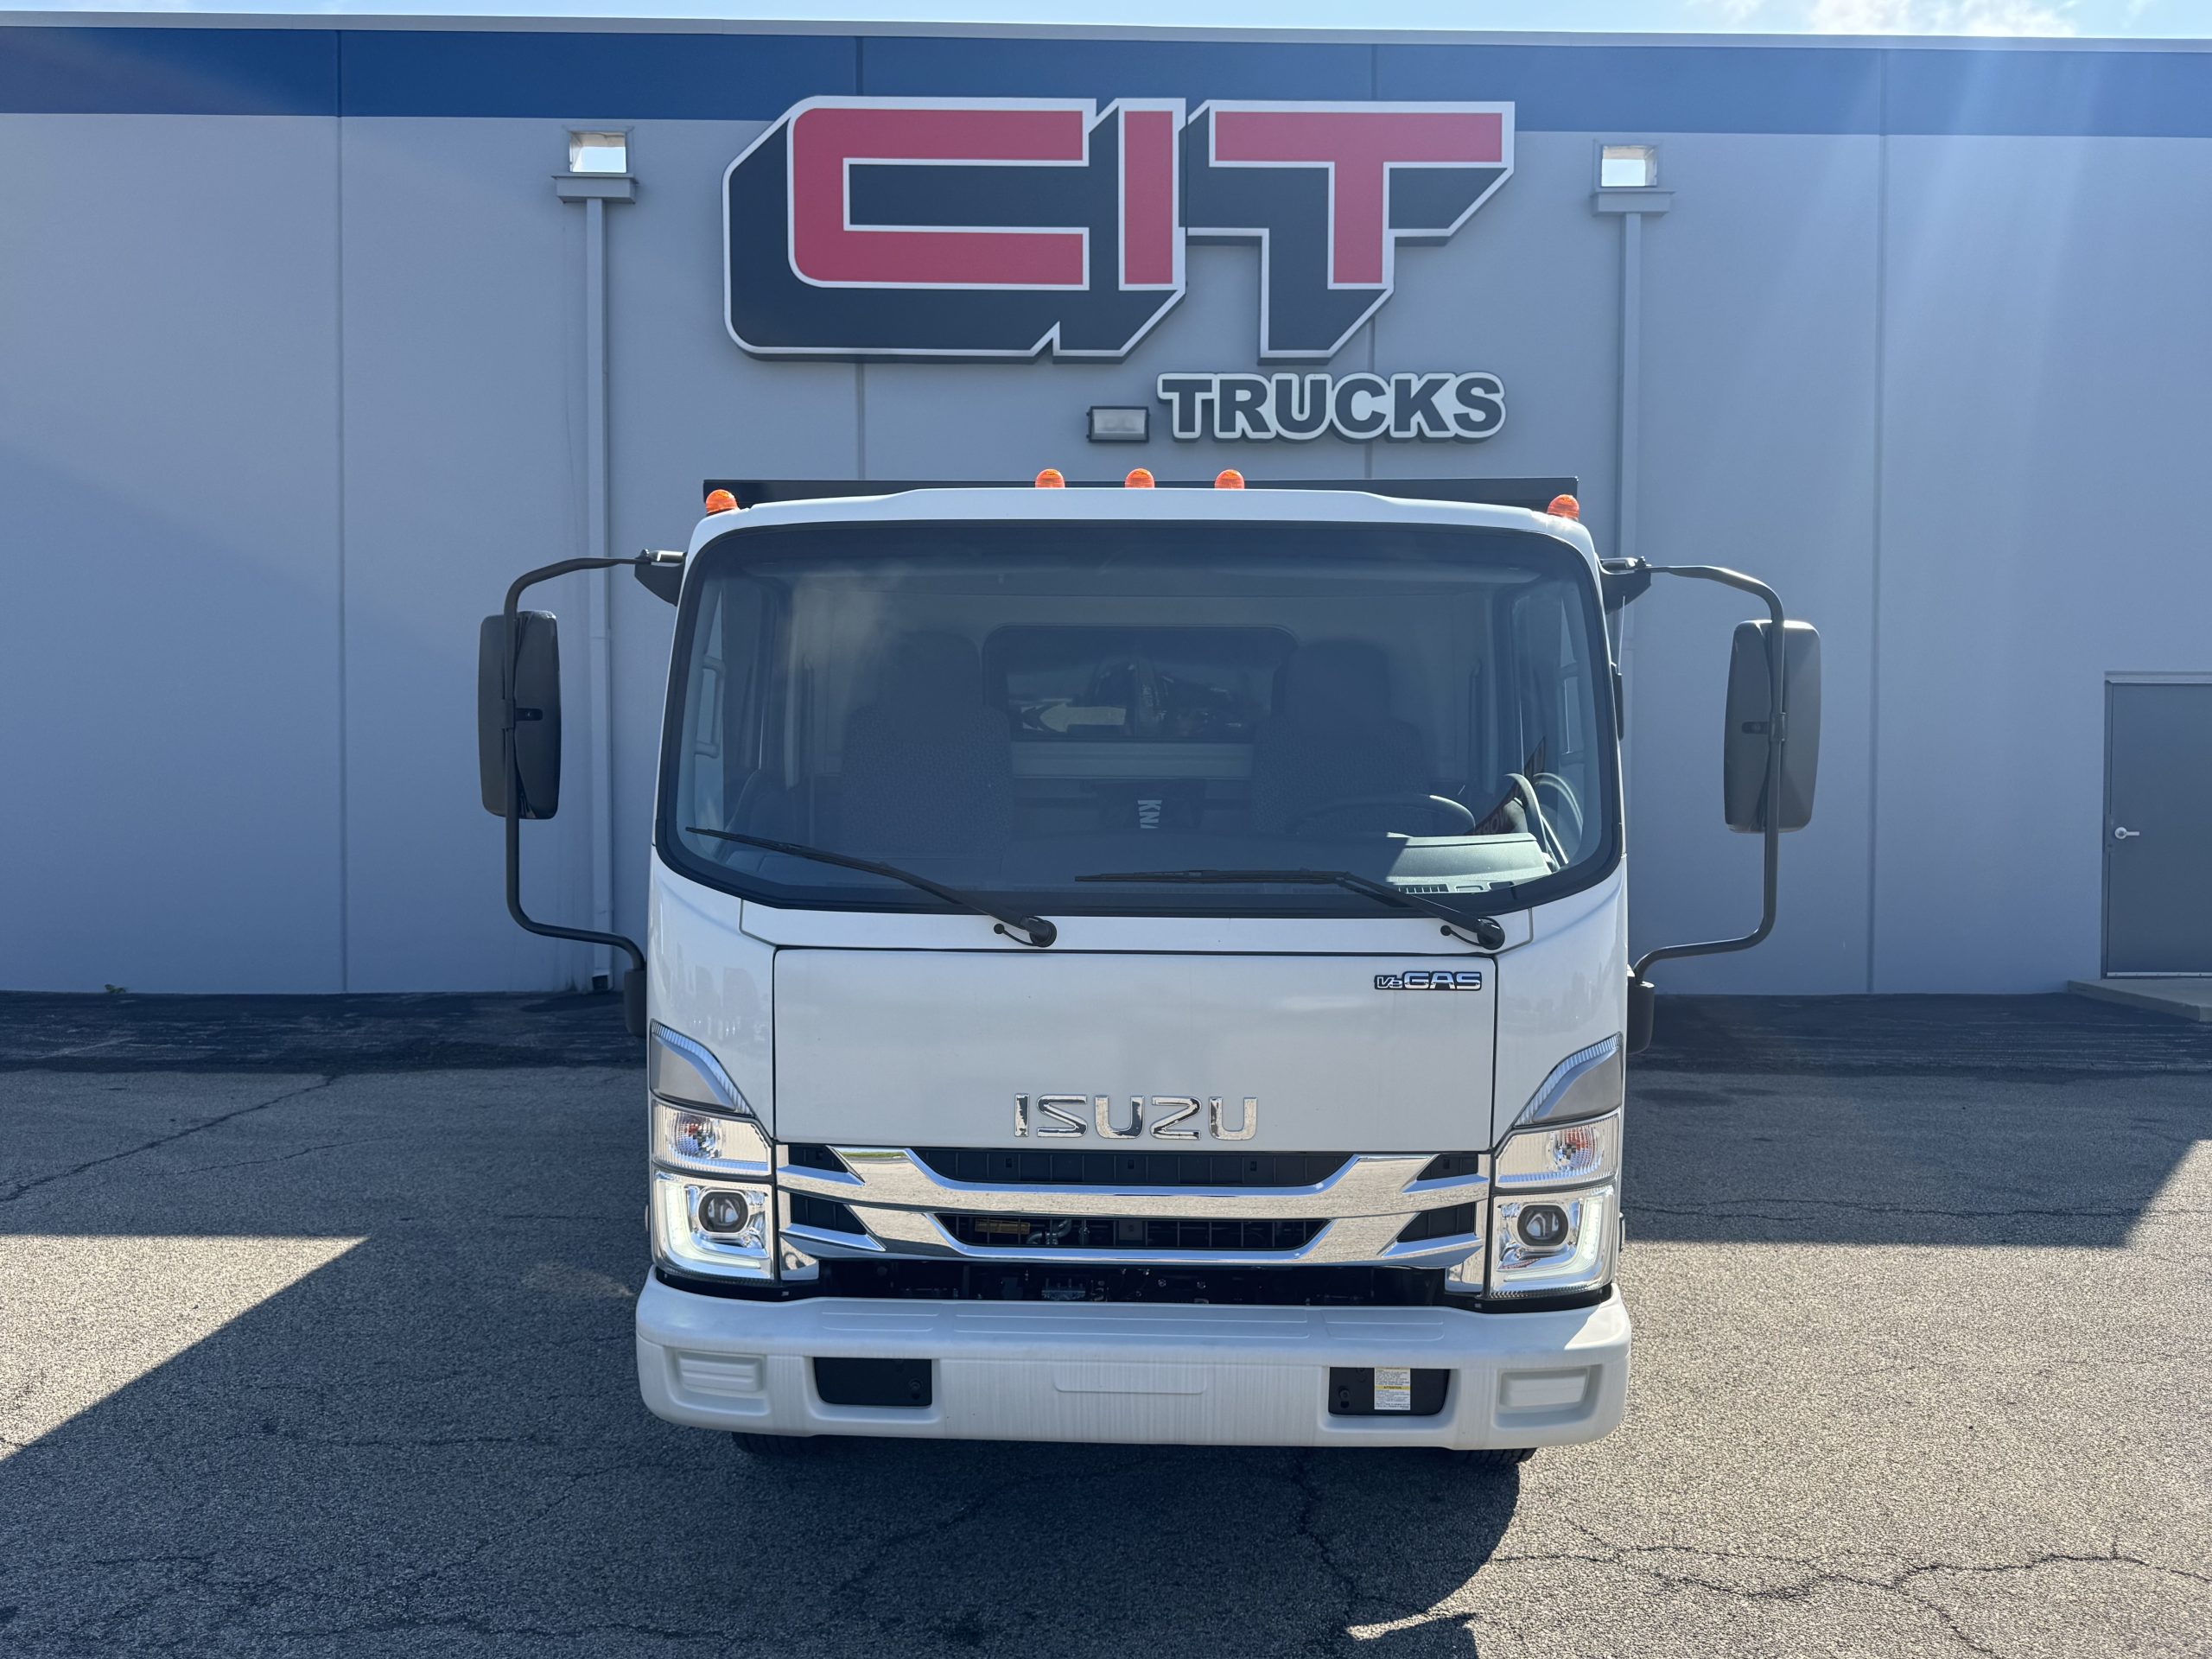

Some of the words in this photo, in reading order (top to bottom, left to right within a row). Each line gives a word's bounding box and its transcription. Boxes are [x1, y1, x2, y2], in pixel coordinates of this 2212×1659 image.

[786, 96, 1516, 291] CIT
[1159, 373, 1506, 440] TRUCKS
[1403, 971, 1481, 990] GAS
[1014, 1093, 1258, 1141] ISUZU
